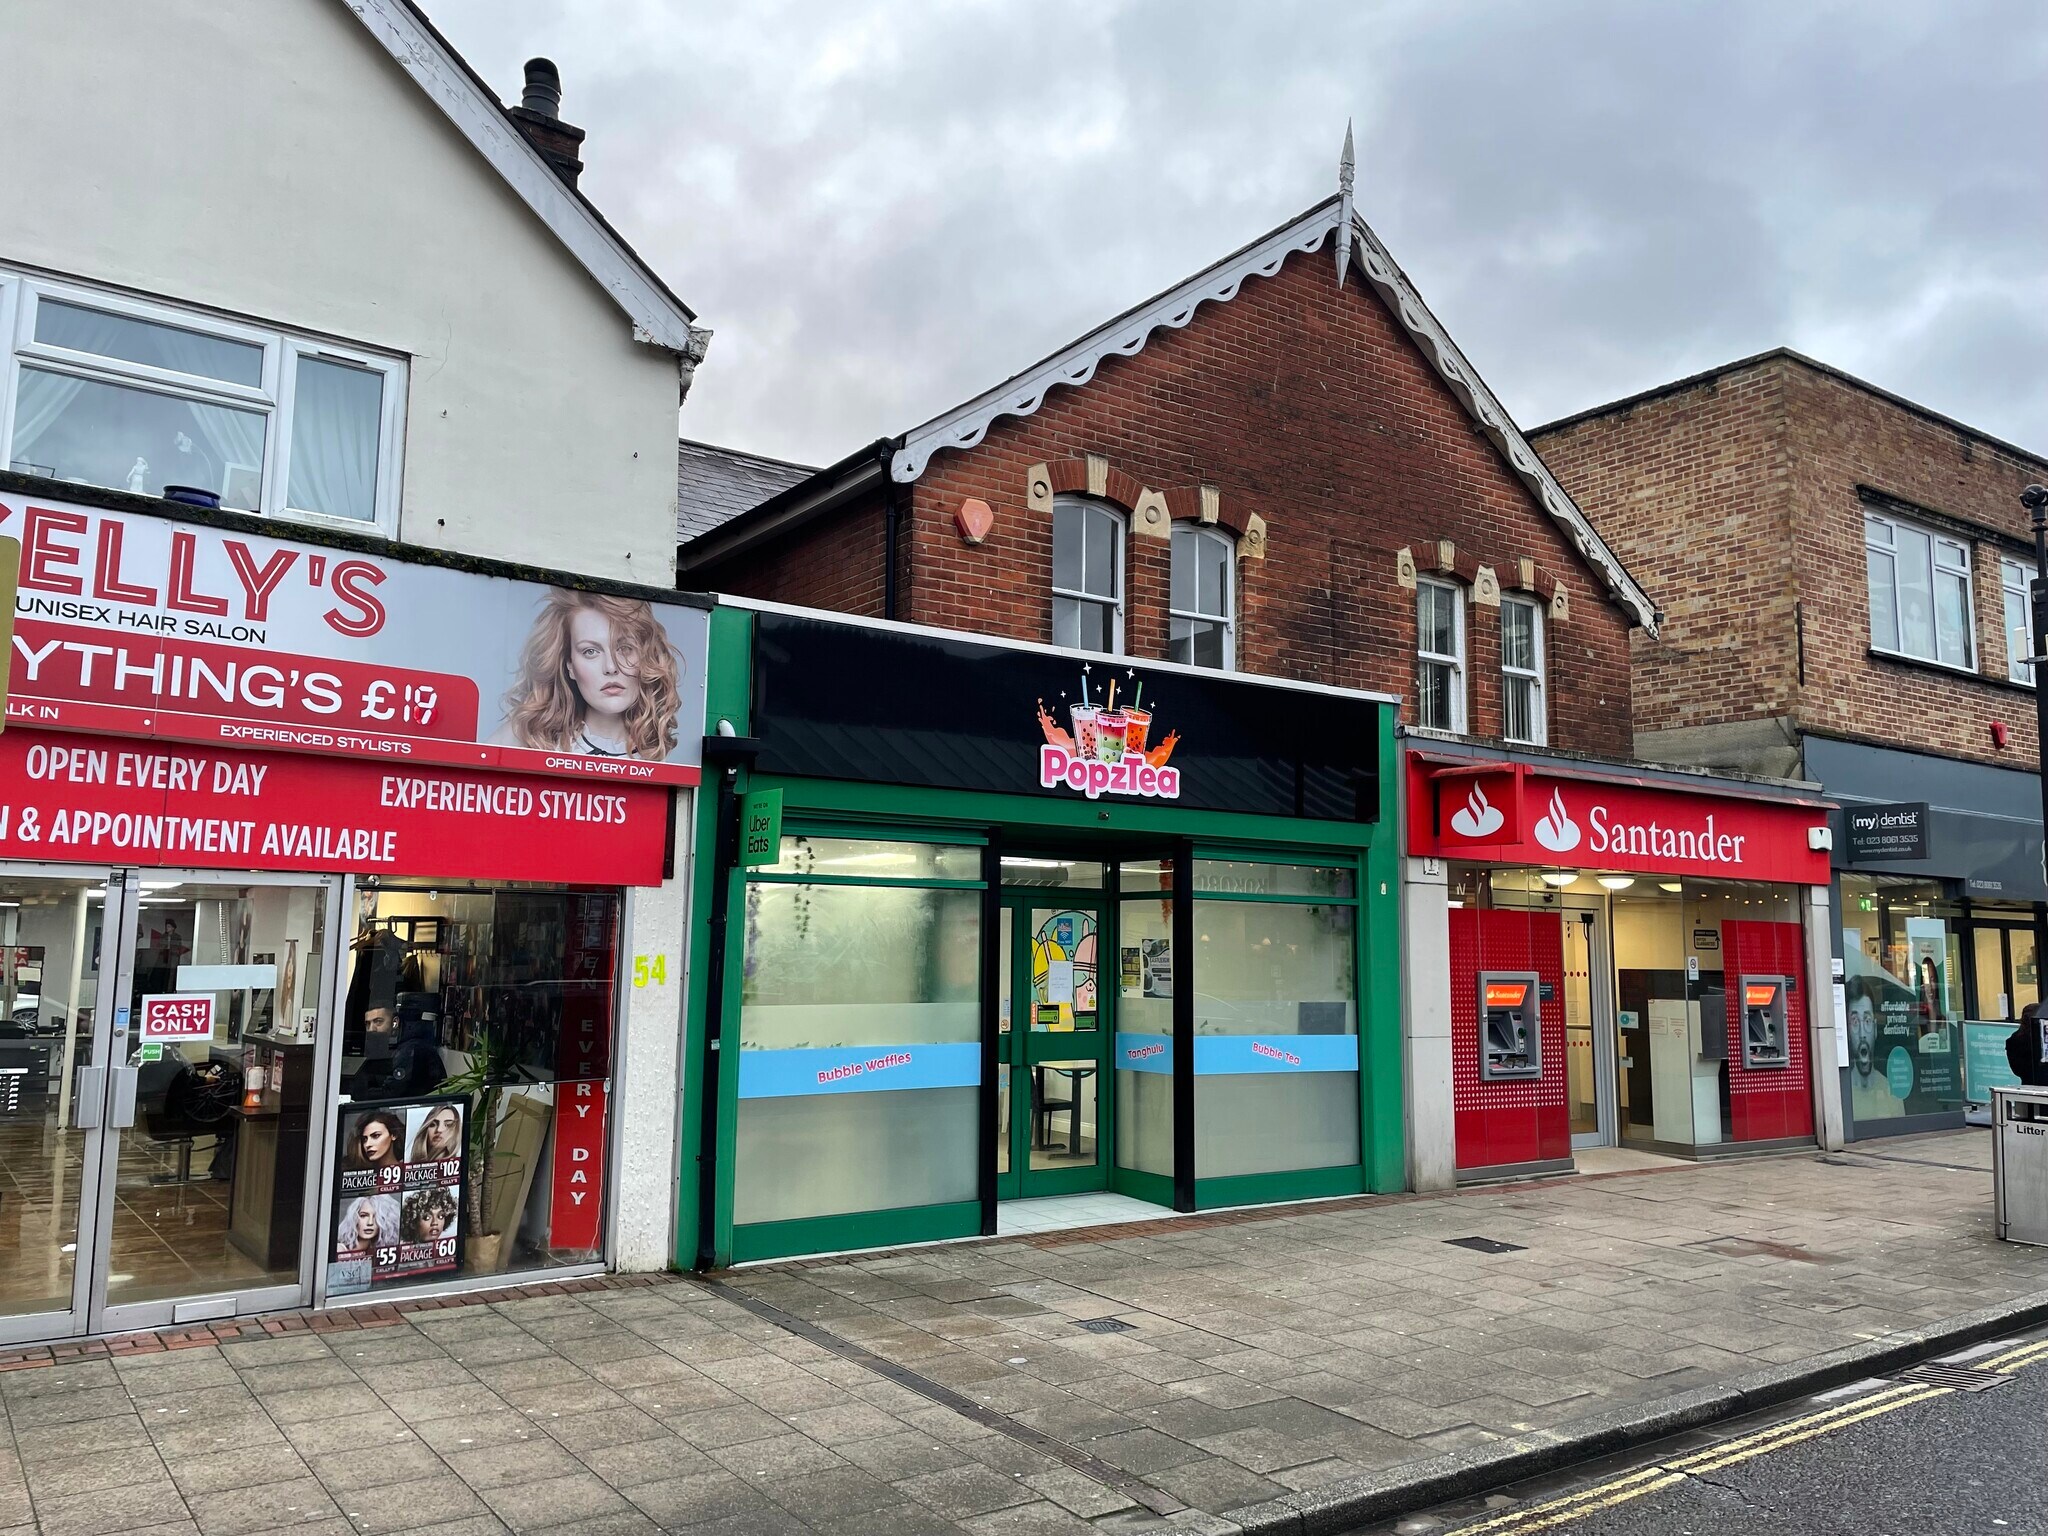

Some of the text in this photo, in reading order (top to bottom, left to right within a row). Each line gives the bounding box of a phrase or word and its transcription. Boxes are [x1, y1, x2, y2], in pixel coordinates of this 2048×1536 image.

[0, 503, 388, 638] ELLY'S
[16, 596, 267, 644] UNISEX HAIR SALON
[12, 635, 344, 714] YTHING'S
[40, 706, 59, 719] IN
[220, 724, 412, 755] EXPERIENCED STYLISTS
[26, 744, 268, 797] OPEN EVERY DAY
[545, 757, 655, 778] OPEN EVERY DAY
[1042, 747, 1180, 797] PopzTea
[381, 776, 627, 825] EXPERIENCED STYLISTS
[749, 815, 770, 833] Uber
[17, 806, 41, 843] &
[49, 808, 256, 854] APPOINTMENT
[261, 823, 398, 863] AVAILABLE
[748, 836, 769, 853] Eats
[1589, 805, 1745, 864] Santander
[1866, 836, 1881, 845] 023
[1899, 834, 1919, 843] 3535
[633, 953, 667, 989] 54
[151, 1003, 206, 1018] CASH
[150, 1018, 206, 1033] ONLY
[1127, 1044, 1164, 1060] Tanghulu
[1252, 1042, 1300, 1066] Bubble Tea
[818, 1053, 911, 1083] Bubble Waffles
[2016, 1124, 2046, 1136] Litter
[379, 1166, 401, 1184] £99
[404, 1168, 437, 1182] PACKAGE
[440, 1160, 460, 1177] £102
[570, 1148, 589, 1206] DAY
[342, 1174, 377, 1189] PACKAGE
[376, 1246, 397, 1266] £55
[400, 1249, 433, 1263] PACKAGE
[436, 1238, 456, 1257] £60
